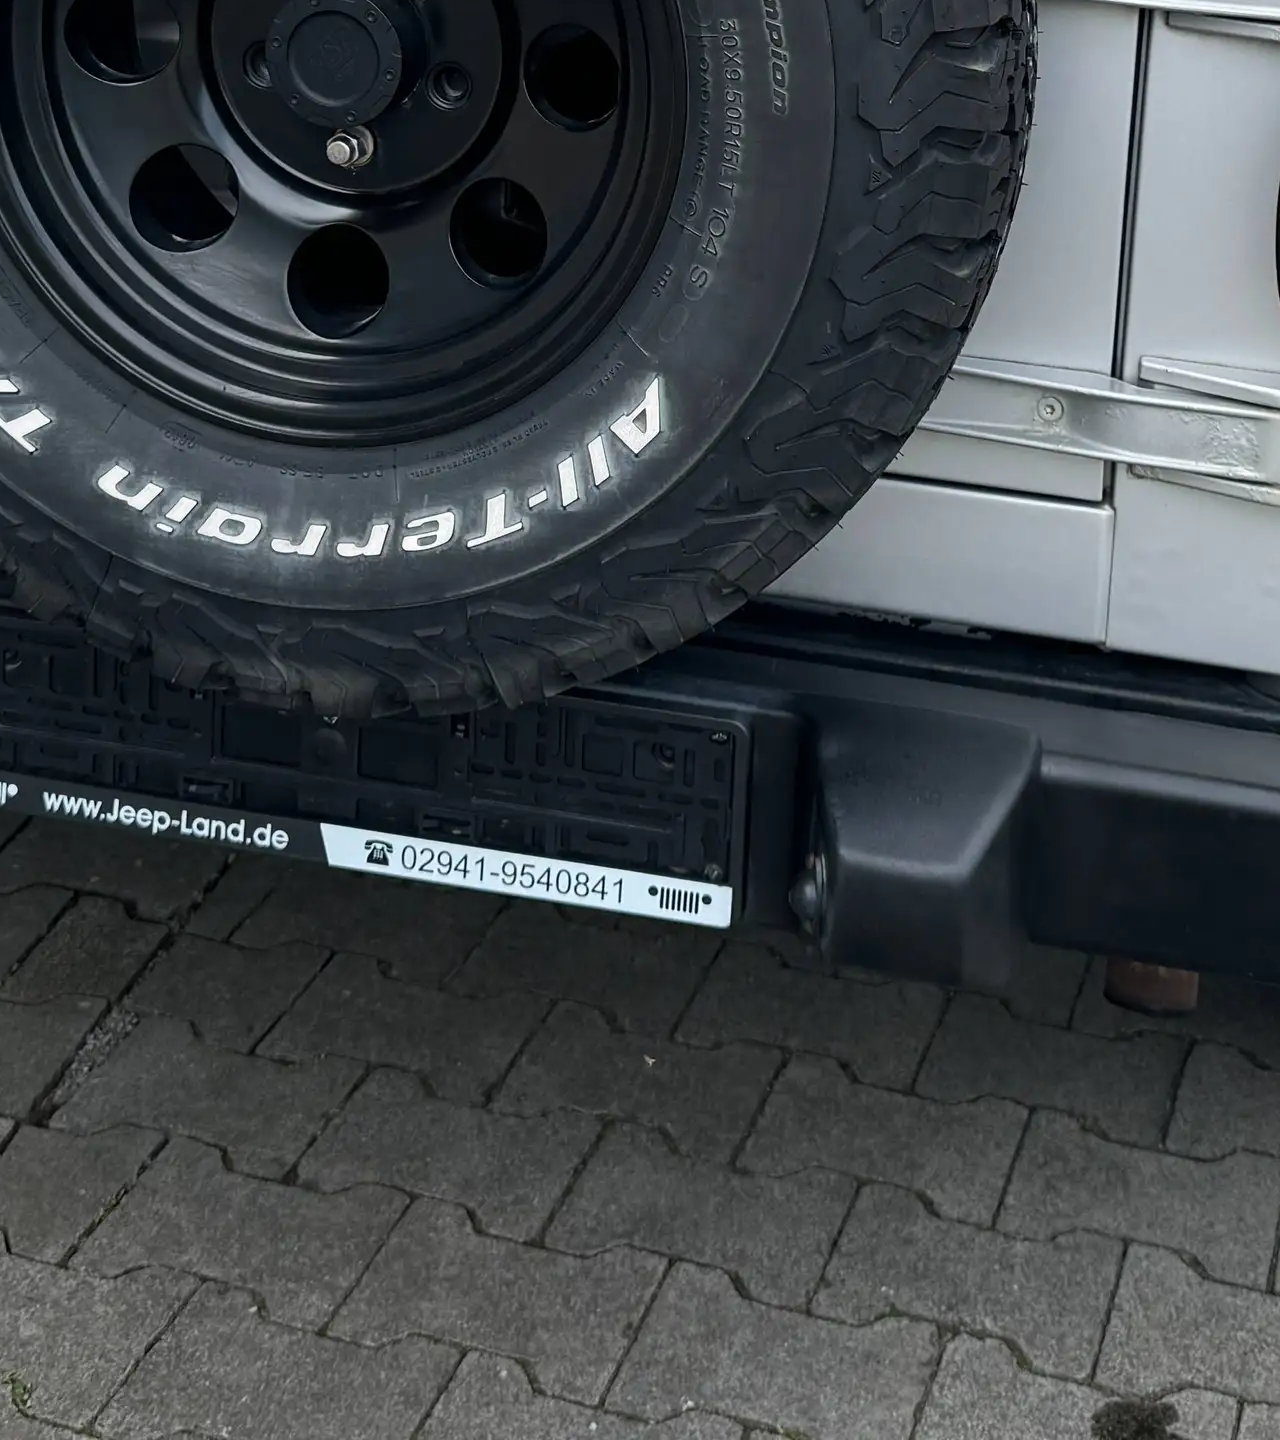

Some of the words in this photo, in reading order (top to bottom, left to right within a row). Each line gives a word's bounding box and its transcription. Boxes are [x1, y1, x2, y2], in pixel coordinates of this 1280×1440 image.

[718, 17, 747, 198] 30X9.50R15LT
[700, 206, 731, 258] 104
[688, 263, 709, 289] S
[95, 376, 671, 560] All-Terrain
[42, 790, 290, 851] www.Jeep-Land.de
[401, 844, 626, 904] 02941-9540841
